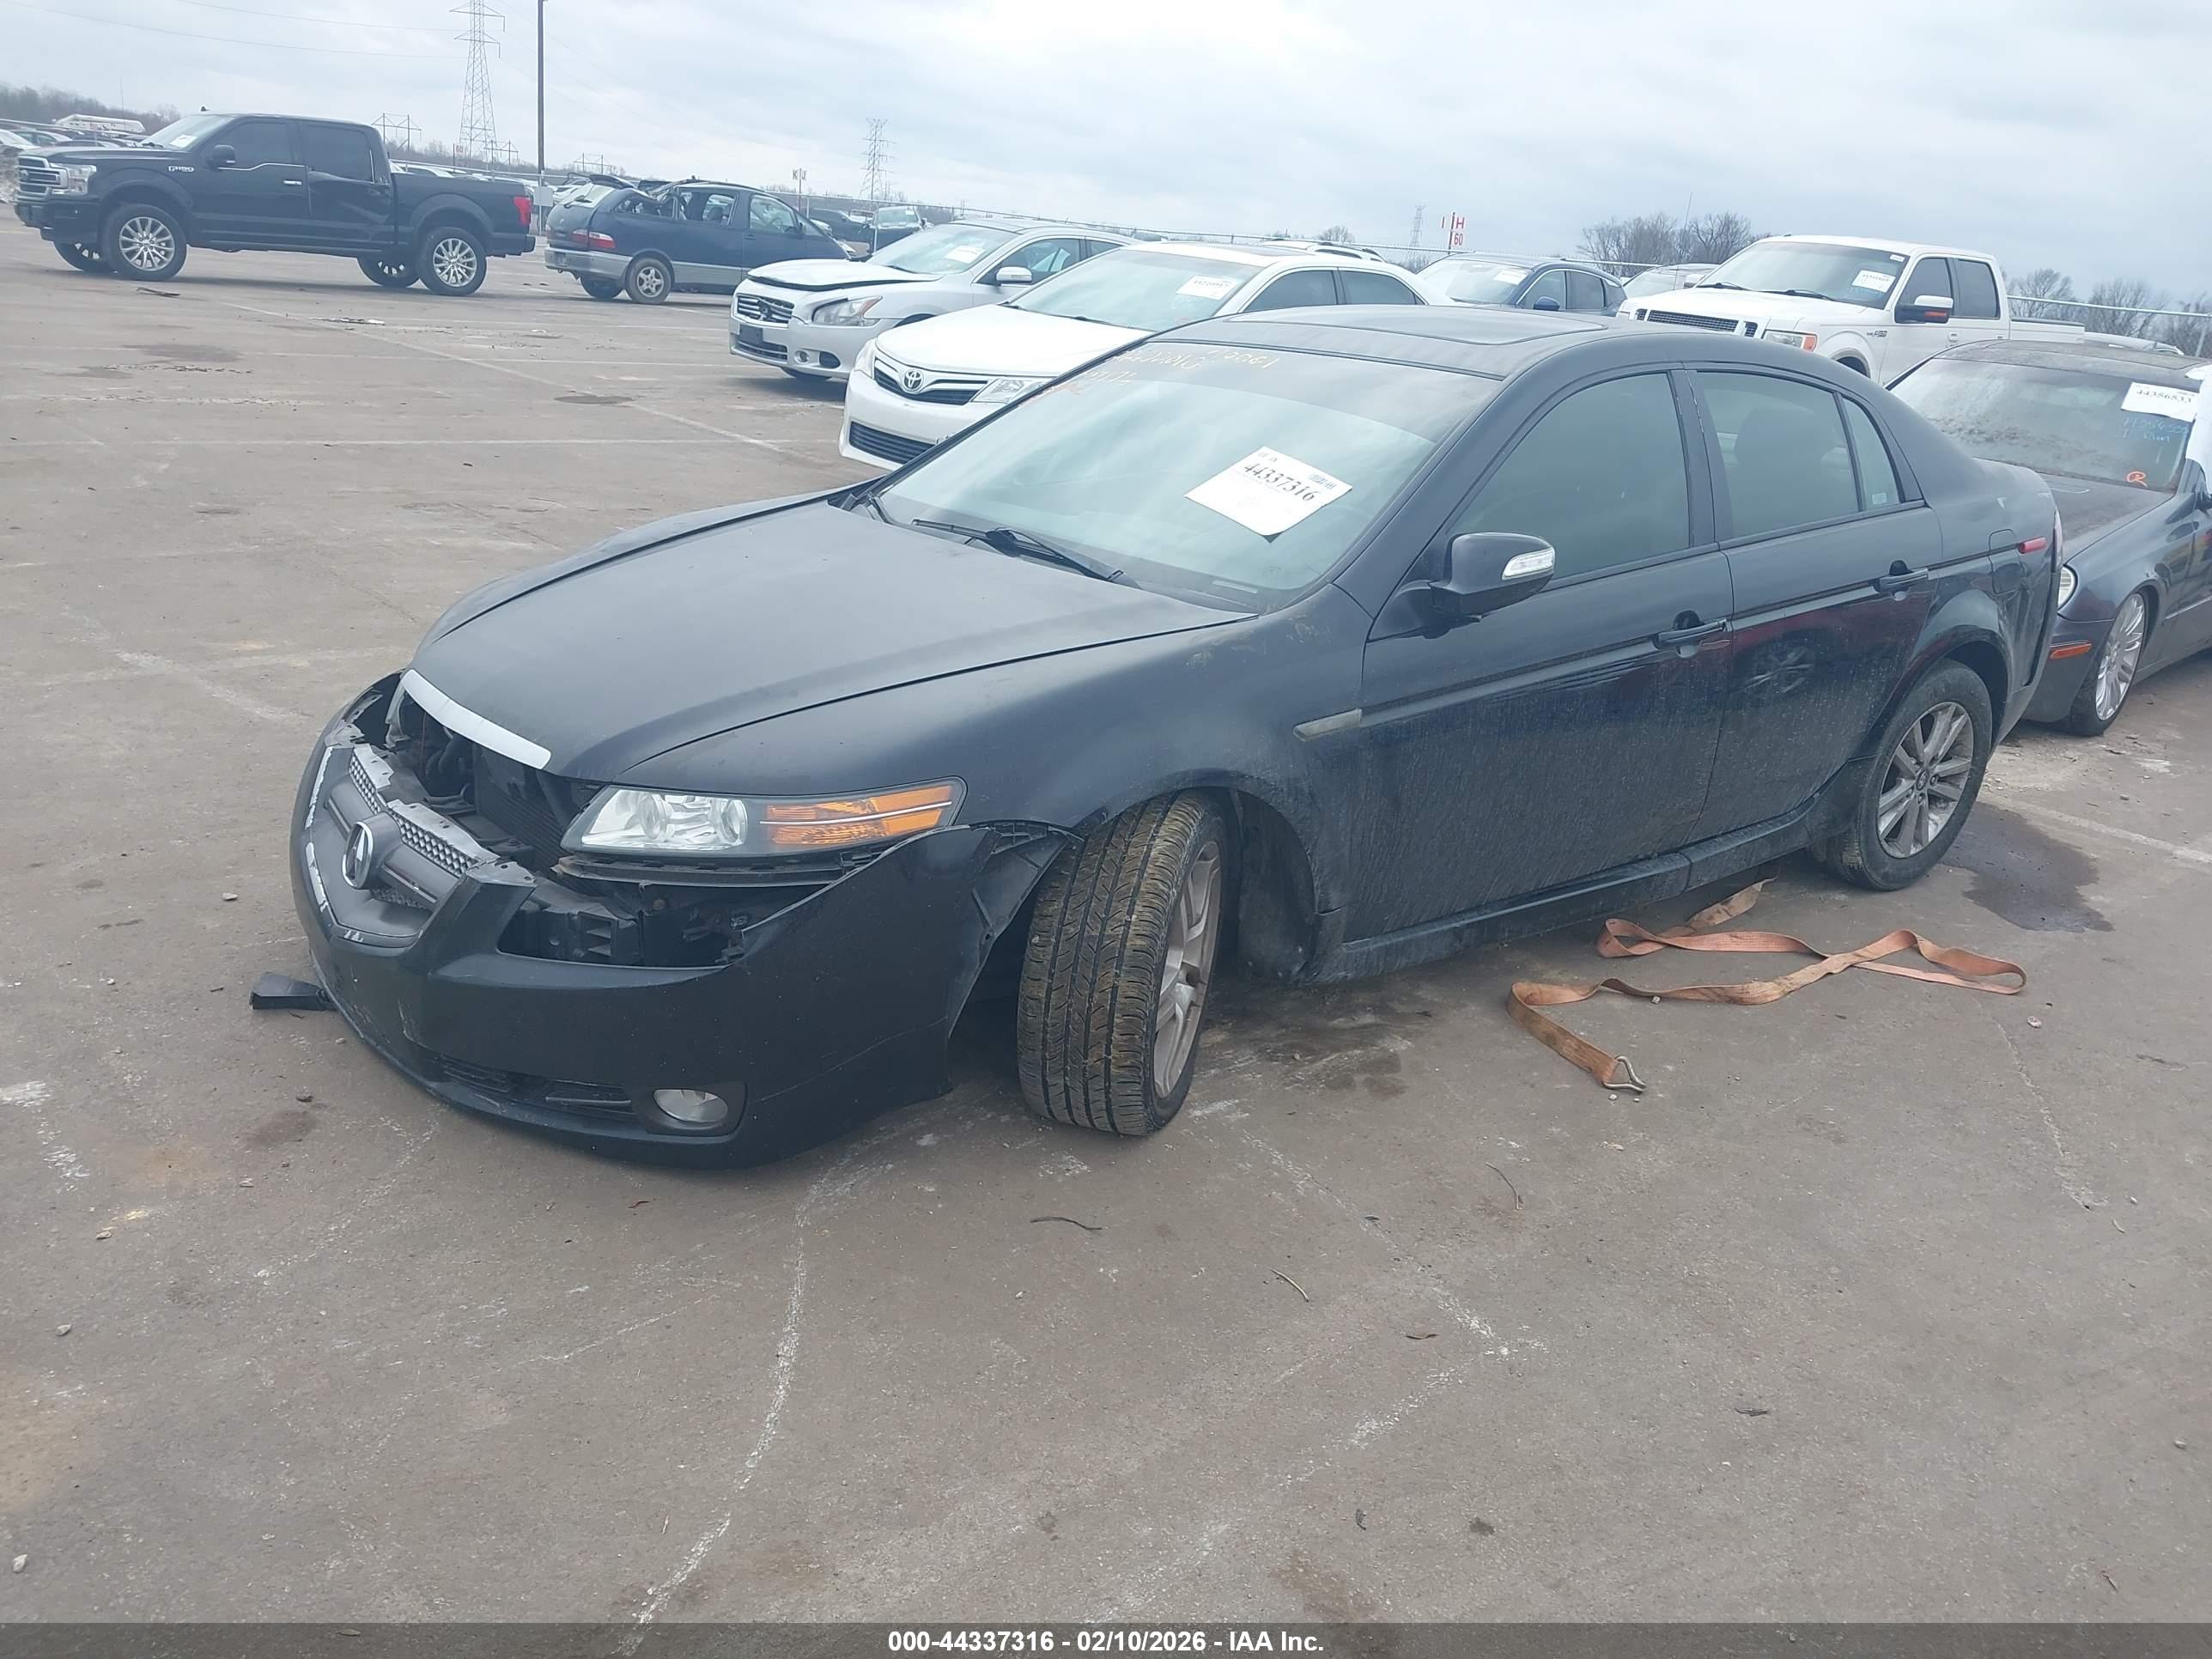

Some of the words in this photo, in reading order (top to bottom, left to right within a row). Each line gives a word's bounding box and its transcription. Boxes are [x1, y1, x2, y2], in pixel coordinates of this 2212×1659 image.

[1455, 216, 1465, 229] H
[1454, 233, 1463, 246] 60
[1243, 462, 1322, 501] 44337316
